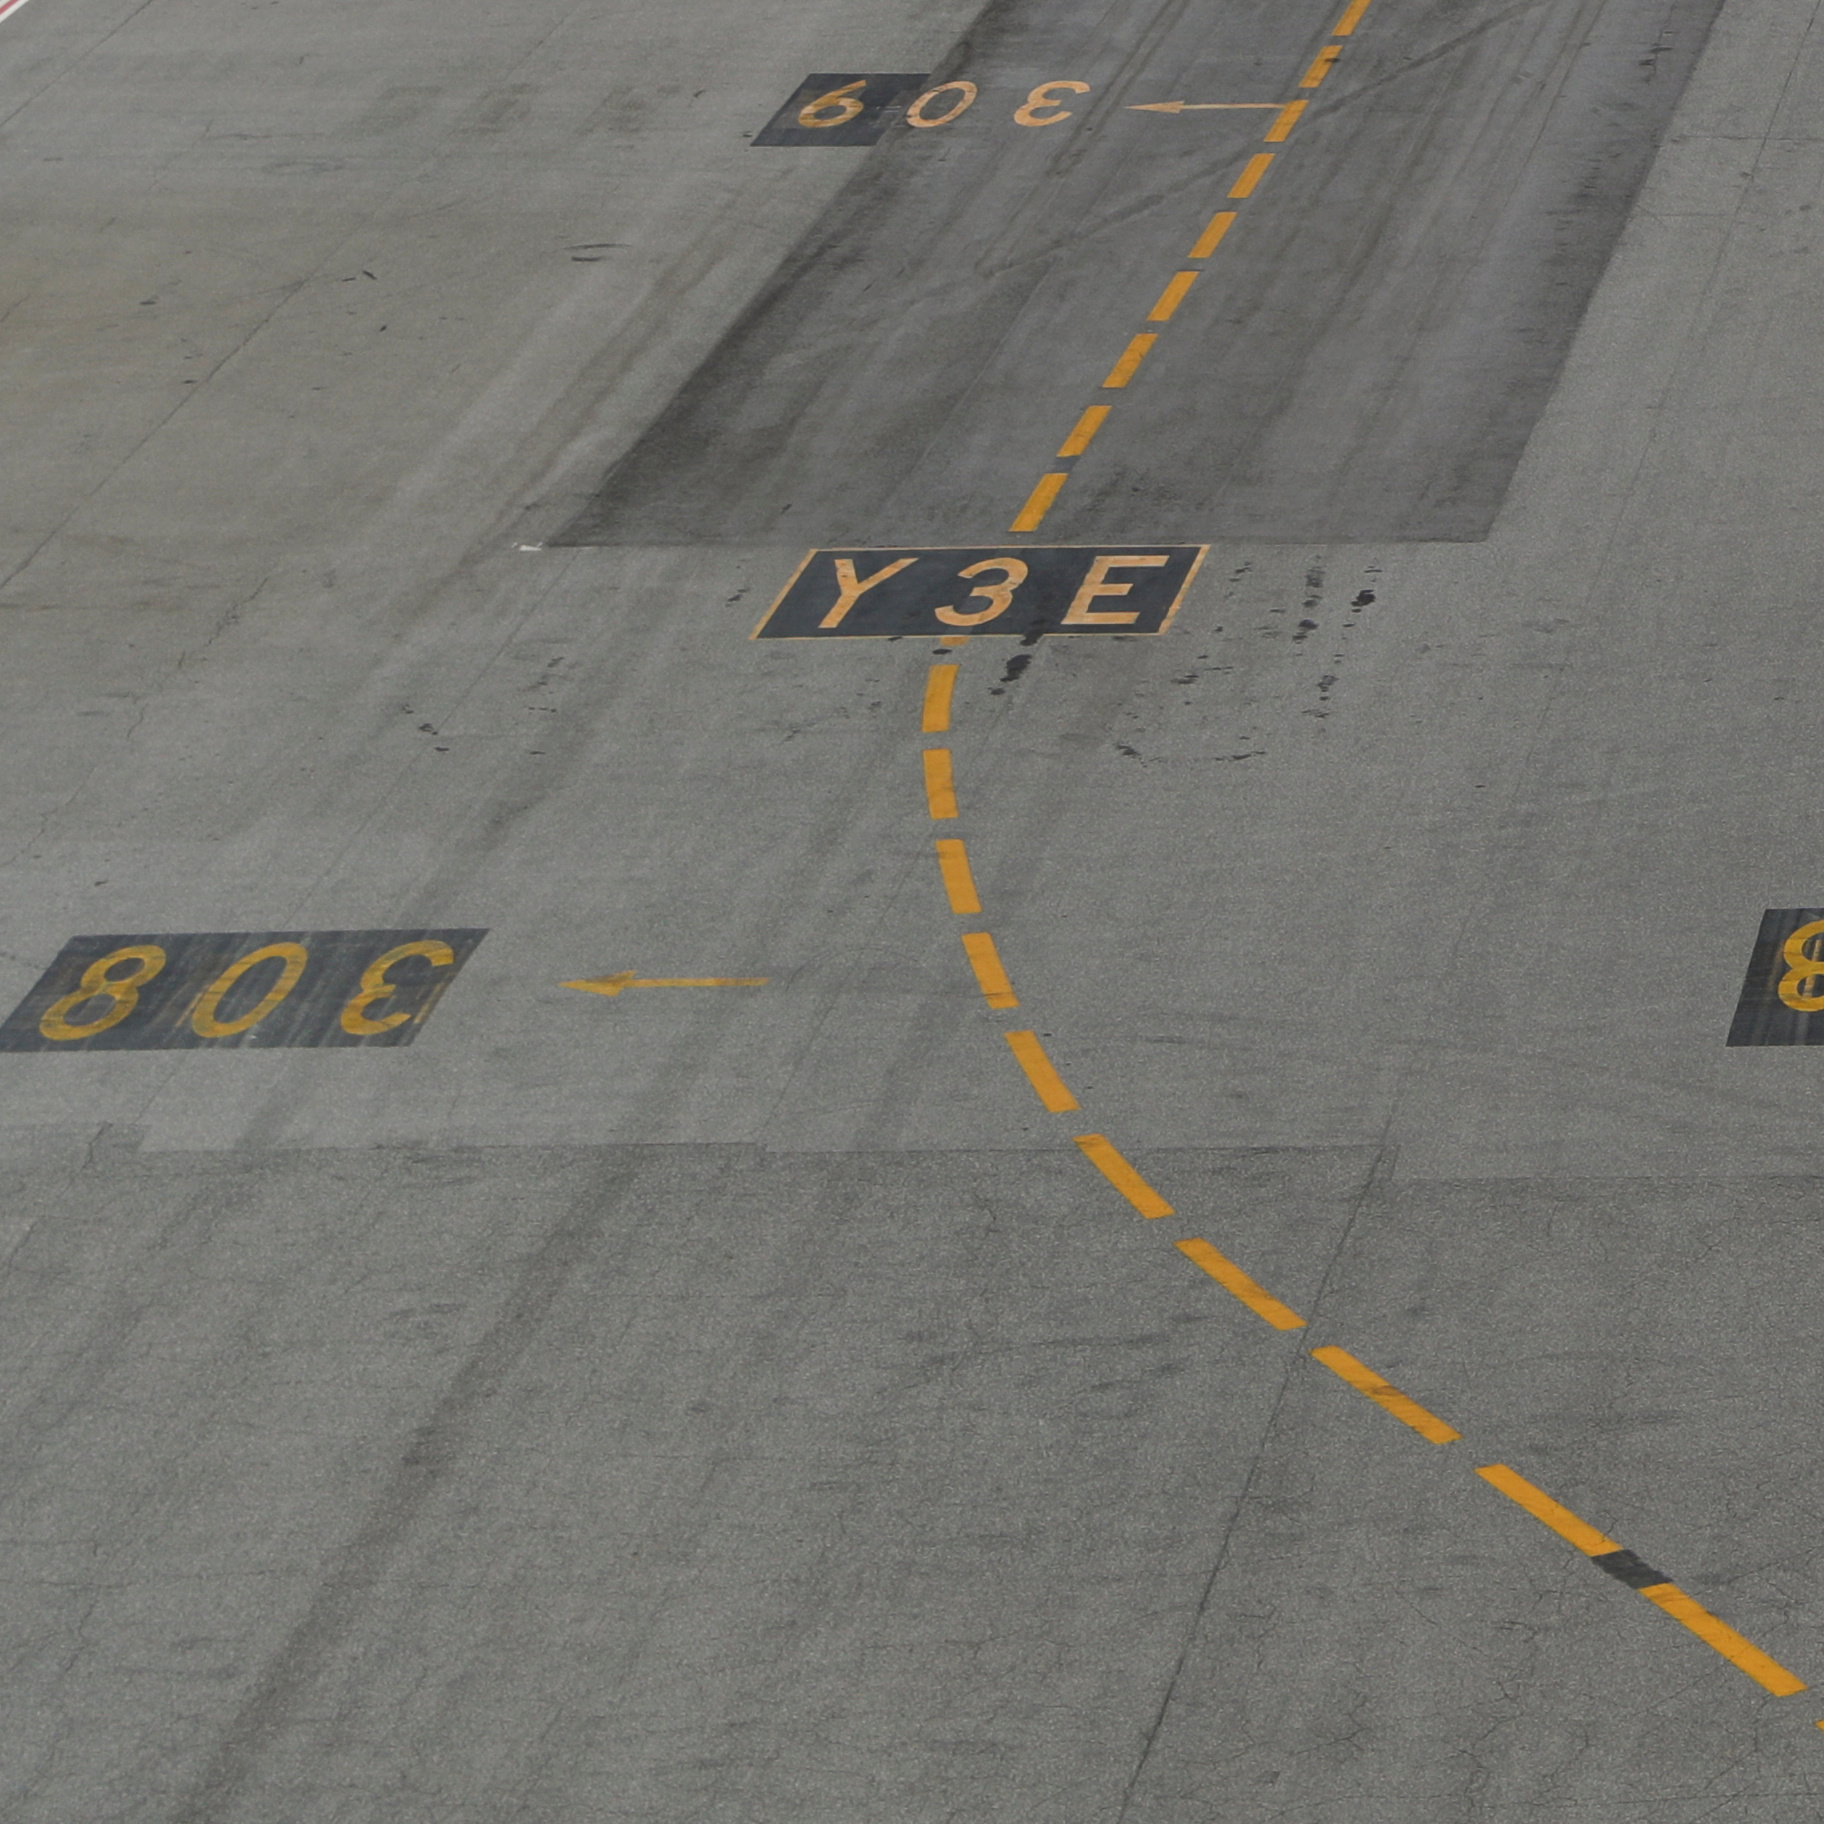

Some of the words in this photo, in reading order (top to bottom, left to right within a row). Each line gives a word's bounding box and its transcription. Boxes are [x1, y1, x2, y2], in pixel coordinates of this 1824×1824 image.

[798, 80, 1093, 130] 309
[819, 555, 1171, 628] Y3E
[38, 939, 456, 1043] 308
